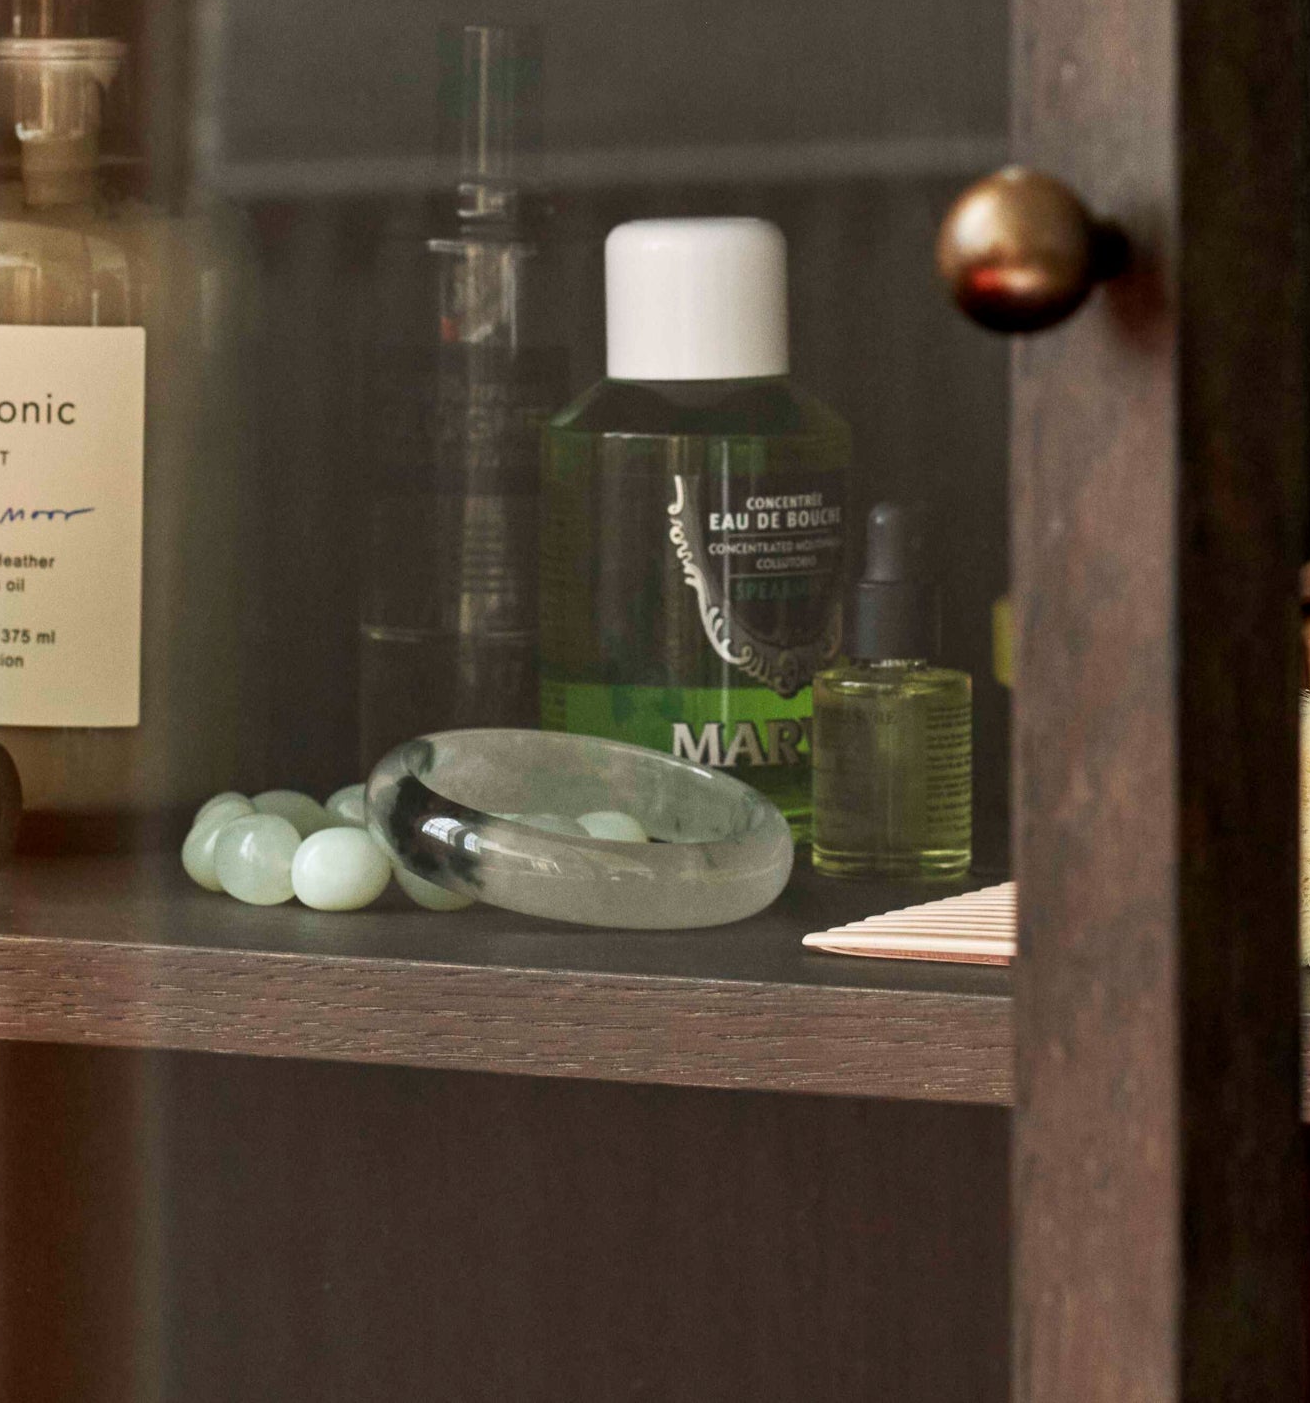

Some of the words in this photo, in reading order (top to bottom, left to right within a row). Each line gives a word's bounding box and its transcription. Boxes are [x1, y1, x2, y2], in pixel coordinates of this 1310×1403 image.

[709, 512, 749, 532] EAU
[757, 511, 781, 530] DE
[786, 506, 842, 529] BOUCHE
[6, 578, 26, 593] oil
[1, 628, 31, 645] 375
[36, 629, 57, 645] ml
